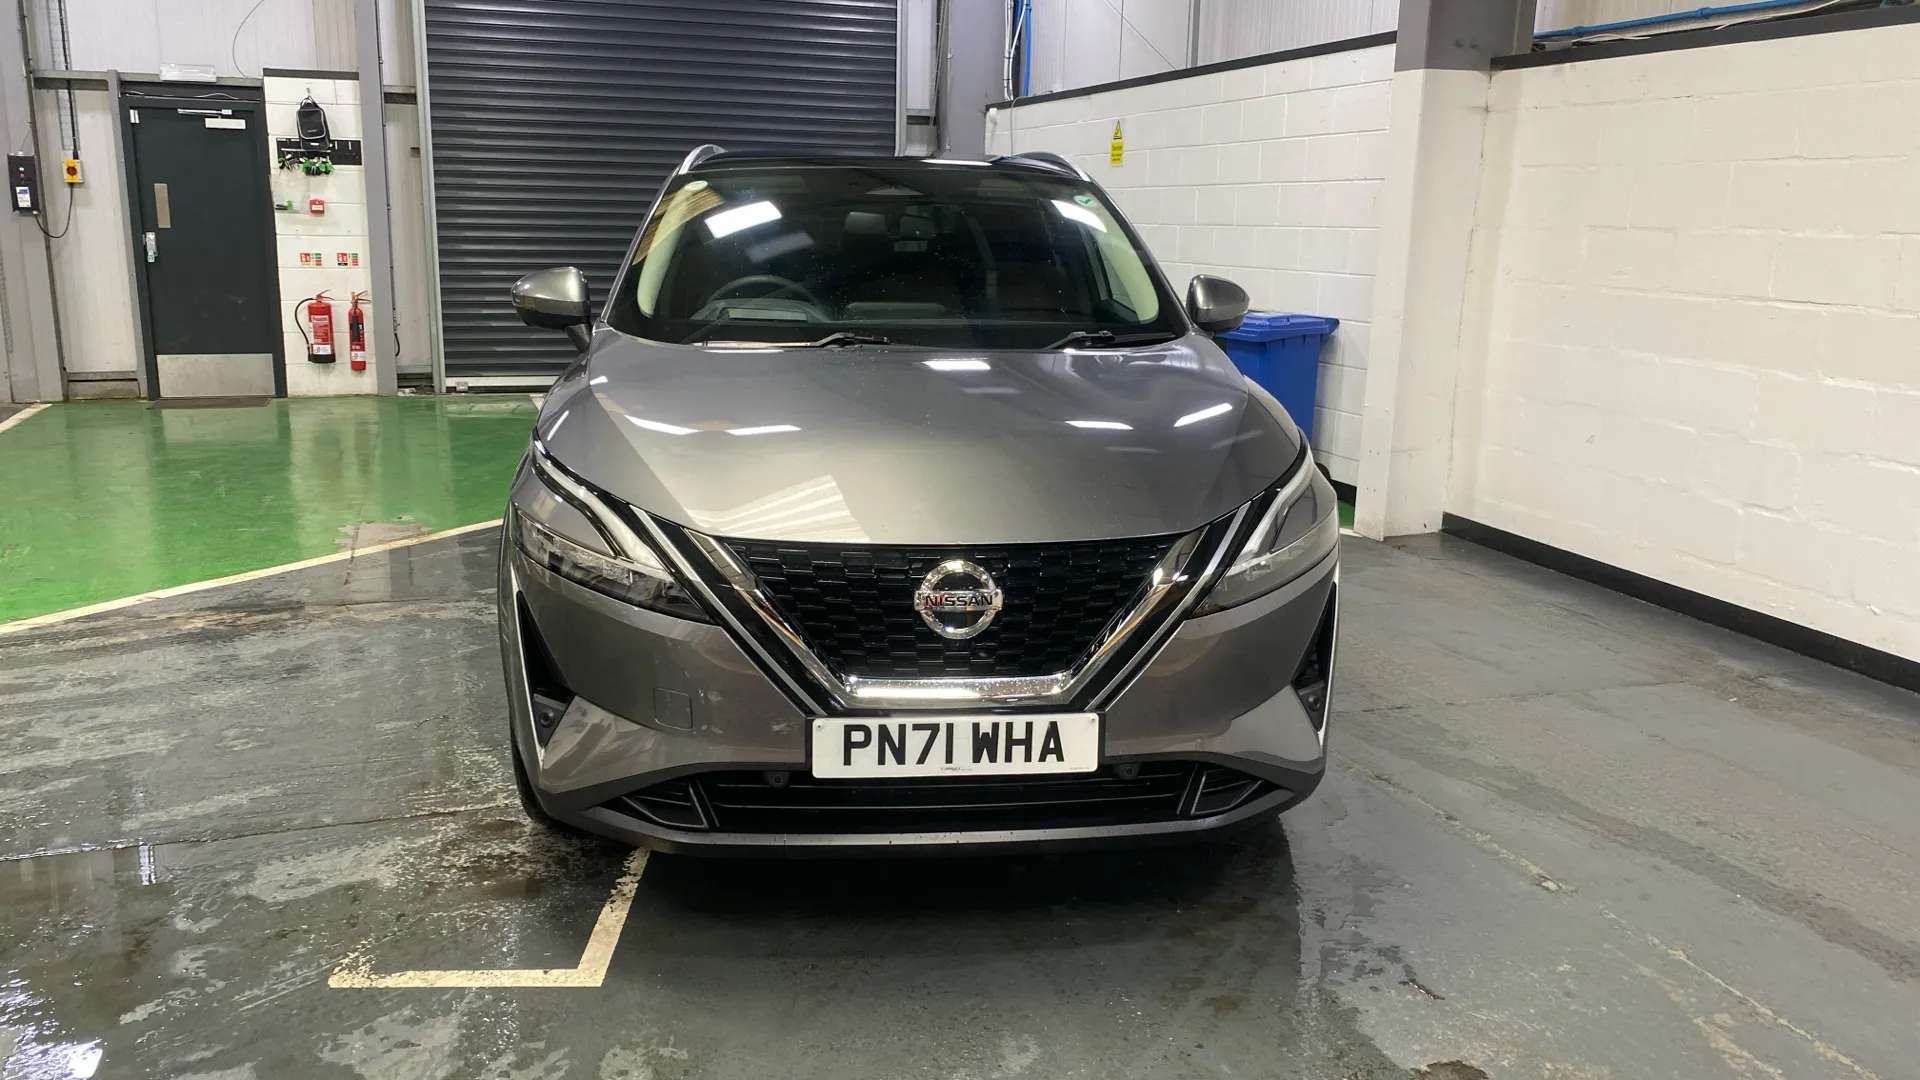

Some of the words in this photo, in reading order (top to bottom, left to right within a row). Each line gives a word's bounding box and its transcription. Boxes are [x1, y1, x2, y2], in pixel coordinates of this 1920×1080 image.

[925, 594, 993, 608] NISSAN
[843, 723, 954, 766] PN71
[972, 721, 1065, 764] WHA
